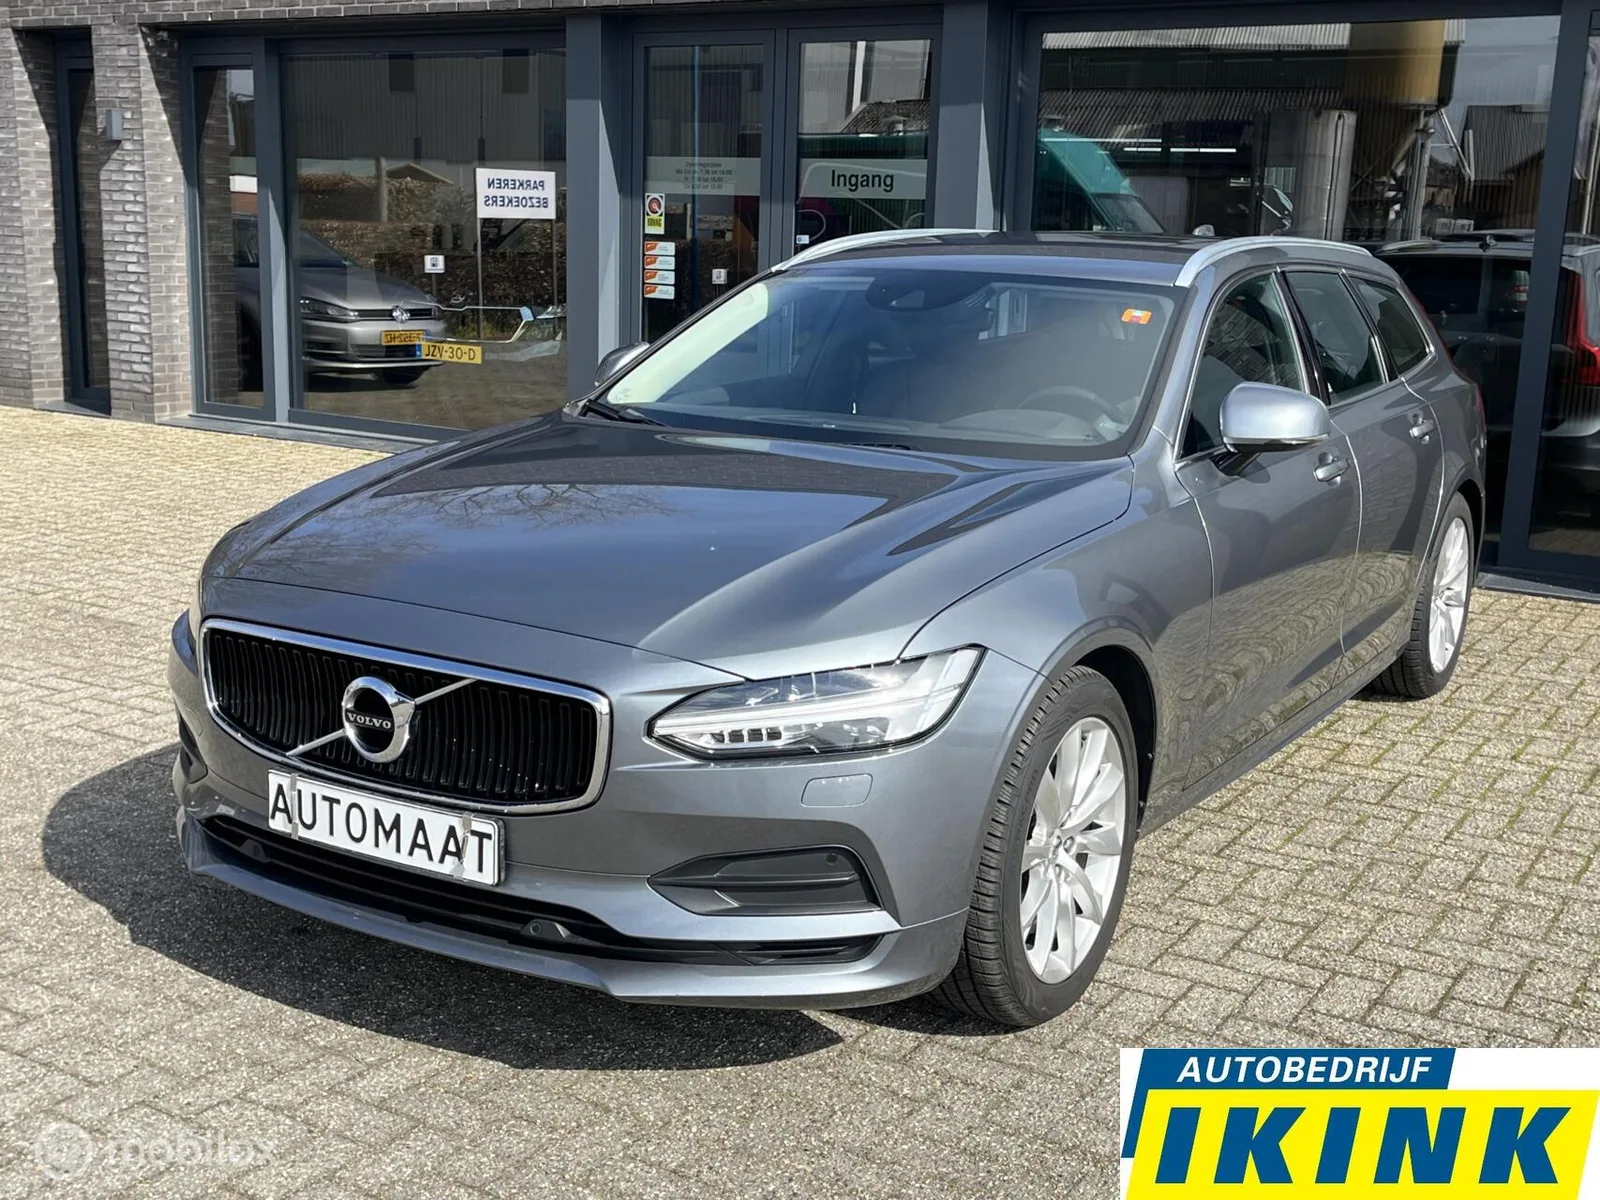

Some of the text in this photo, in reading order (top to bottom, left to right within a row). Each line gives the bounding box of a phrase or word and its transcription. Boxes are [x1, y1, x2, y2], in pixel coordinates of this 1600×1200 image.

[831, 169, 894, 192] Ingang
[425, 346, 476, 361] JZV-30-D
[346, 712, 392, 730] VOLVO
[270, 783, 492, 873] AUTOMAAT
